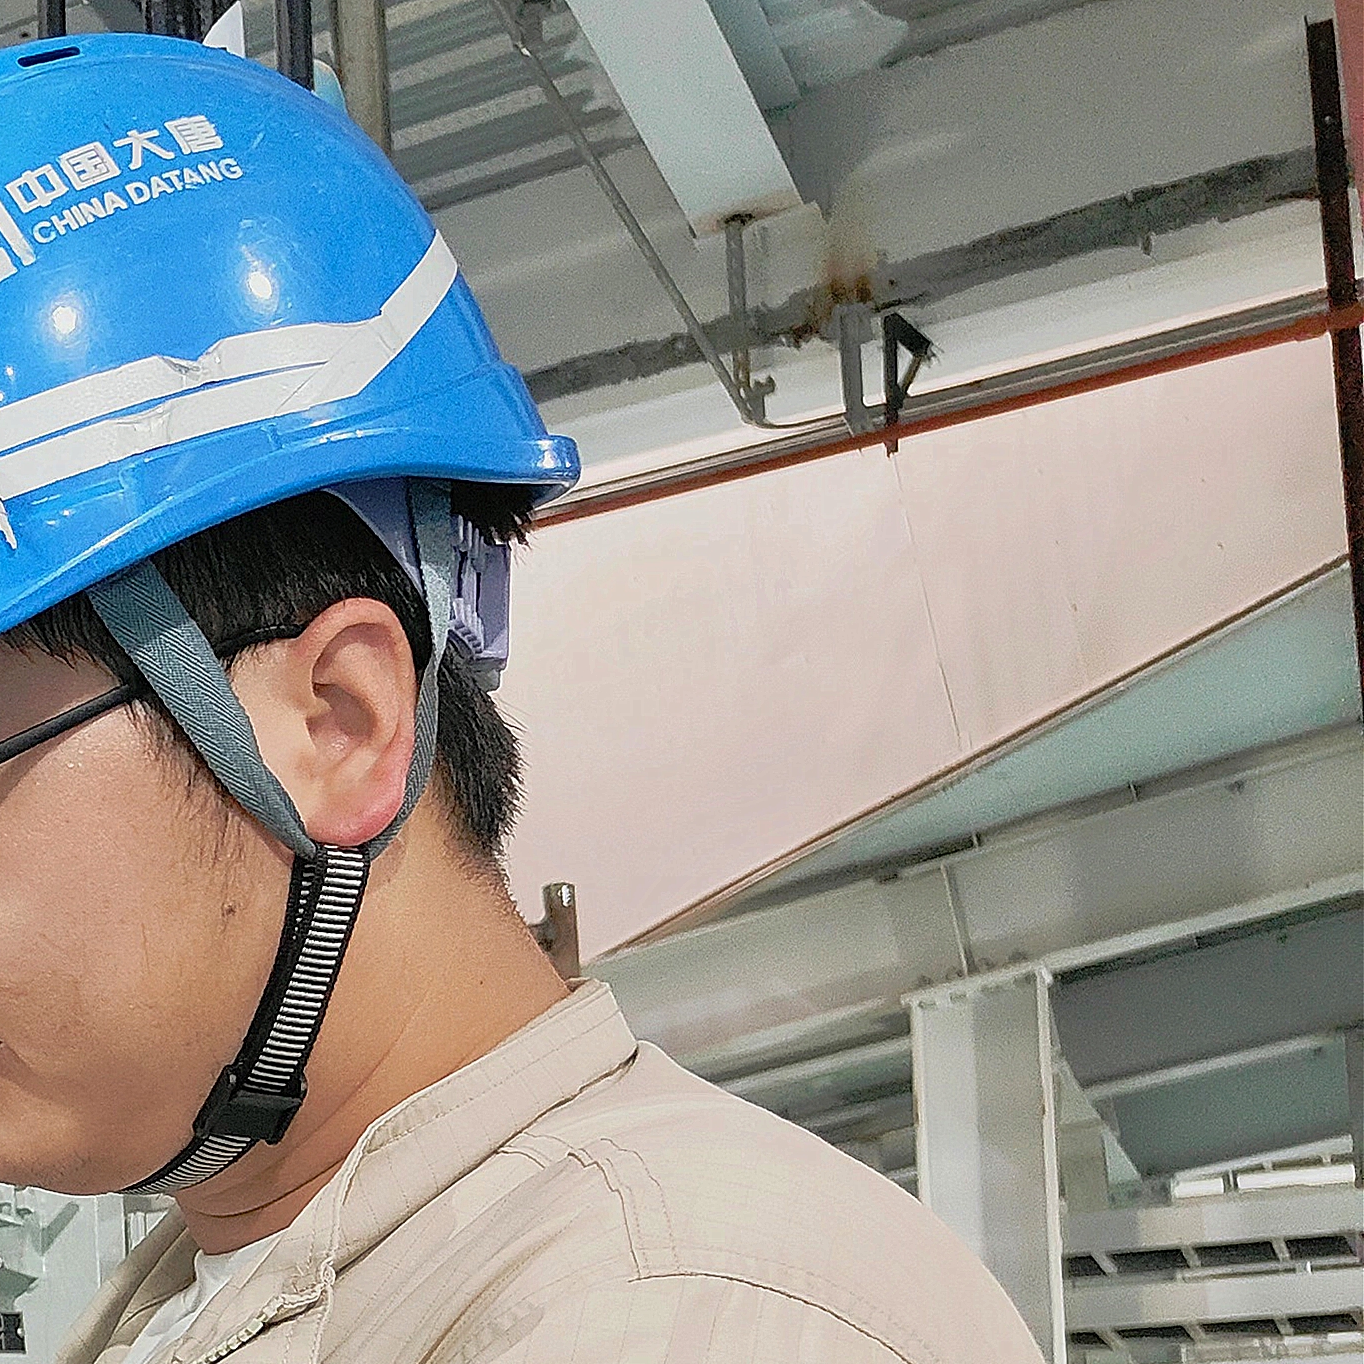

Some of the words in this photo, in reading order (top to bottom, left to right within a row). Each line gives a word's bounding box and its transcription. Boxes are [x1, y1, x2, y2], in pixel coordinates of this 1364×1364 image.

[5, 113, 224, 215] 中国大唐
[31, 189, 126, 245] CHINA
[124, 156, 243, 208] DATANG
